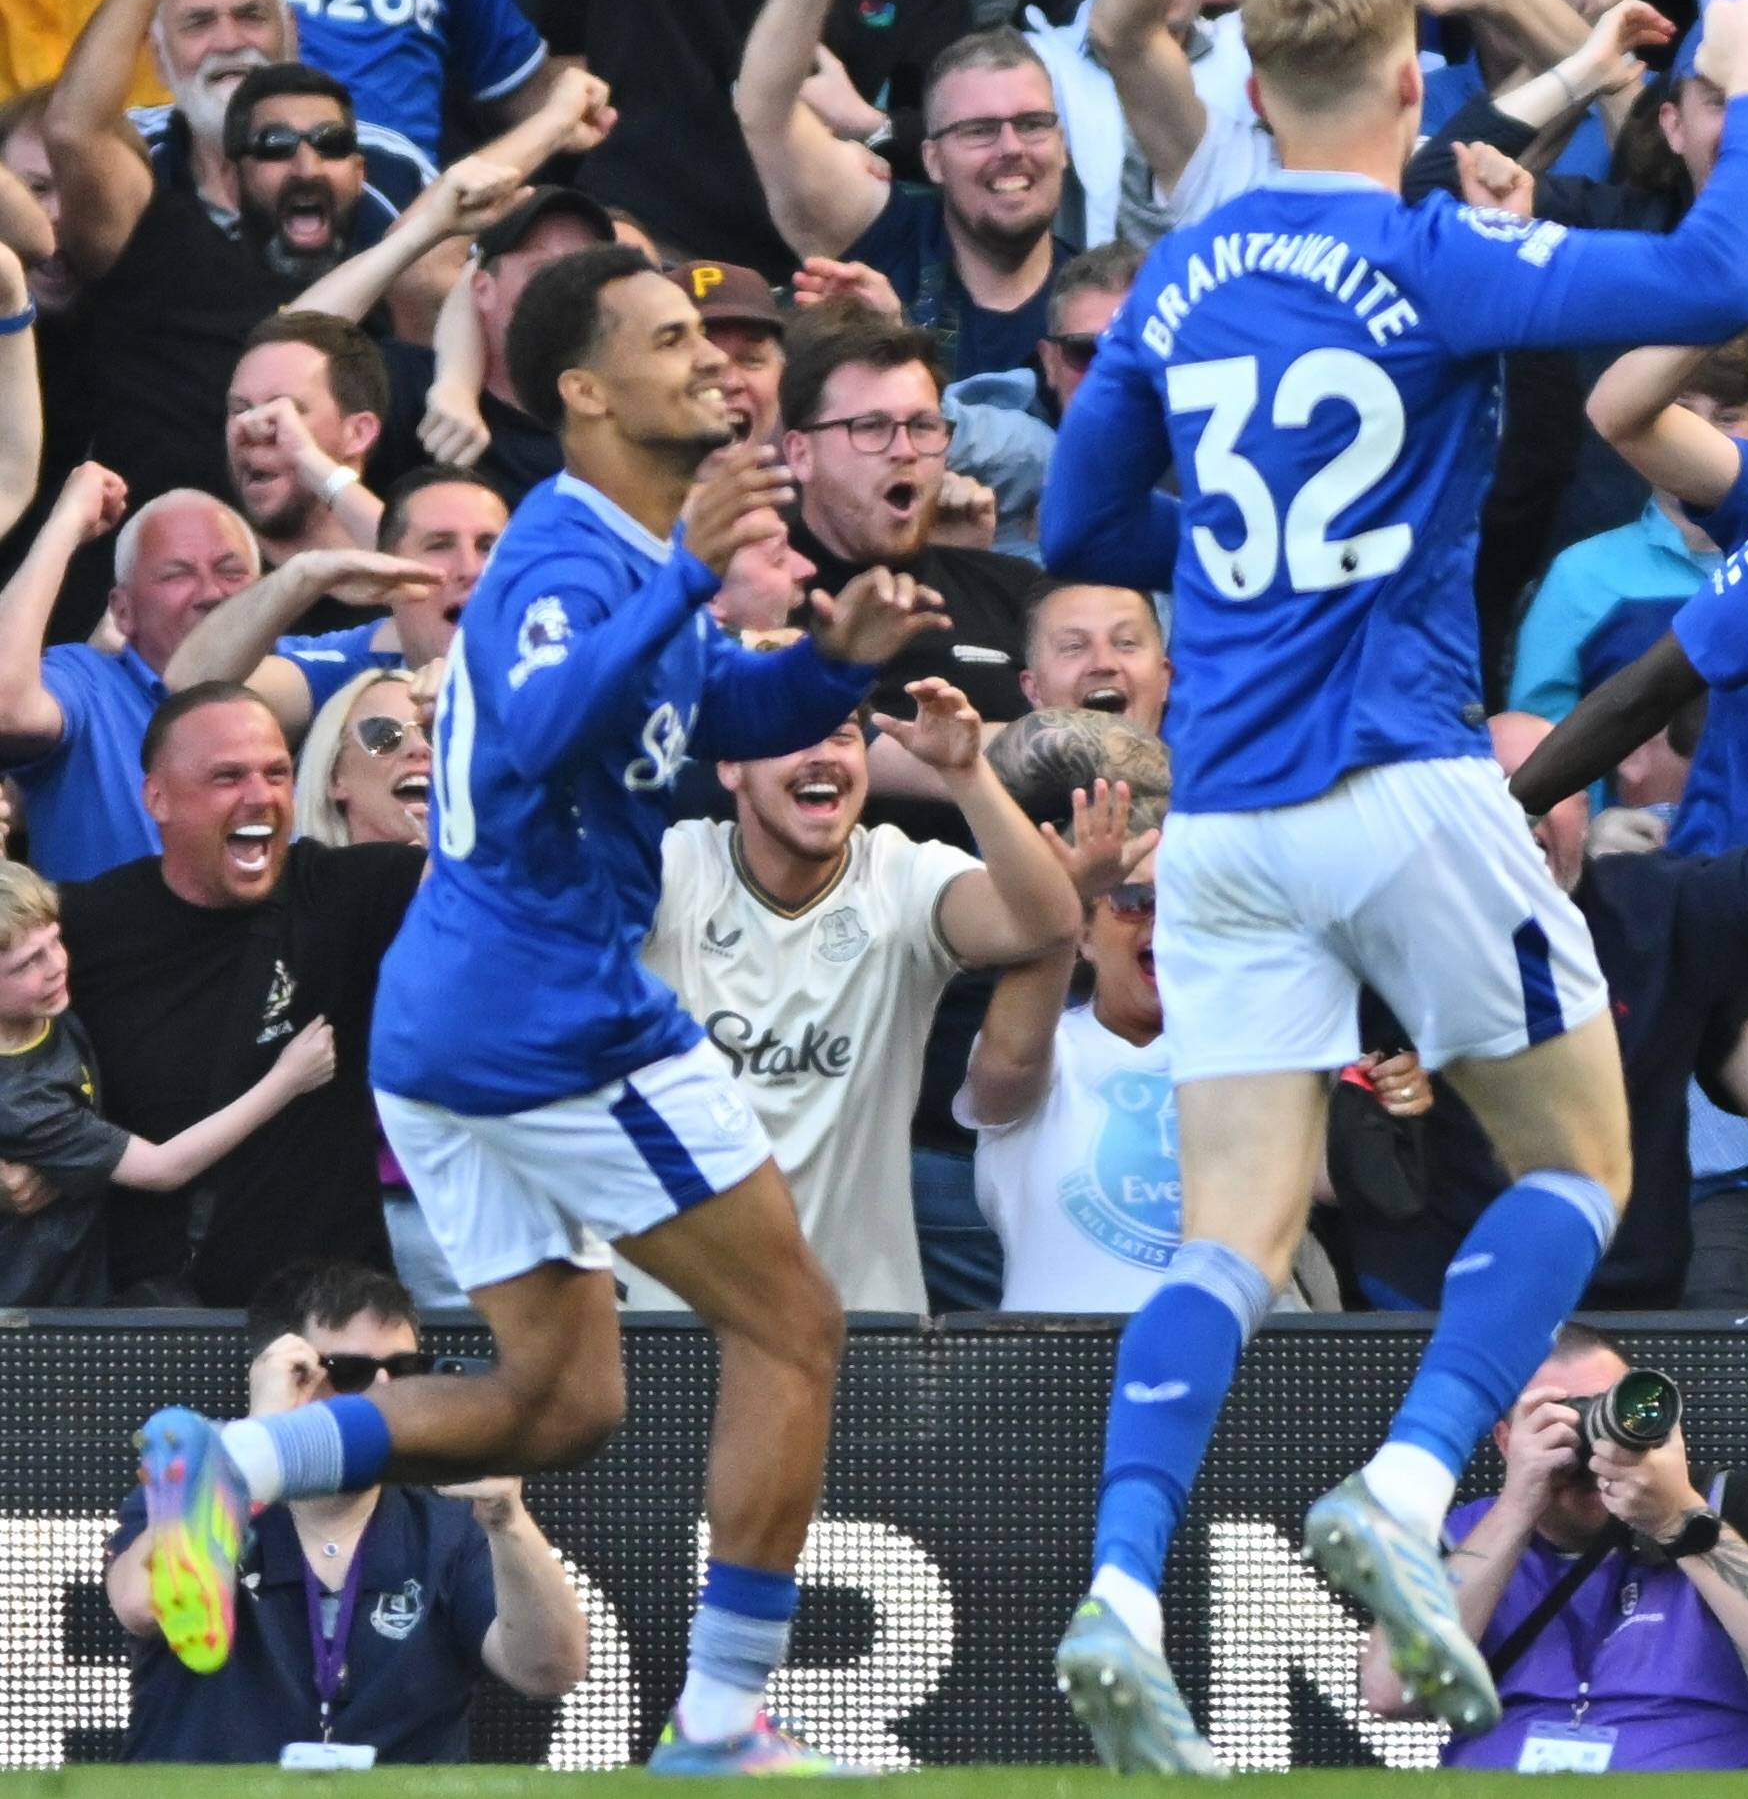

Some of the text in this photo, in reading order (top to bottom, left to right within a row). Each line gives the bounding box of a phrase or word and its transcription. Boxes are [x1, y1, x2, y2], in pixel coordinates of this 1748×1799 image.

[692, 267, 723, 298] P
[1142, 233, 1418, 359] BRANTHWAITE
[1166, 347, 1413, 600] 32
[705, 1010, 852, 1080] Stake
